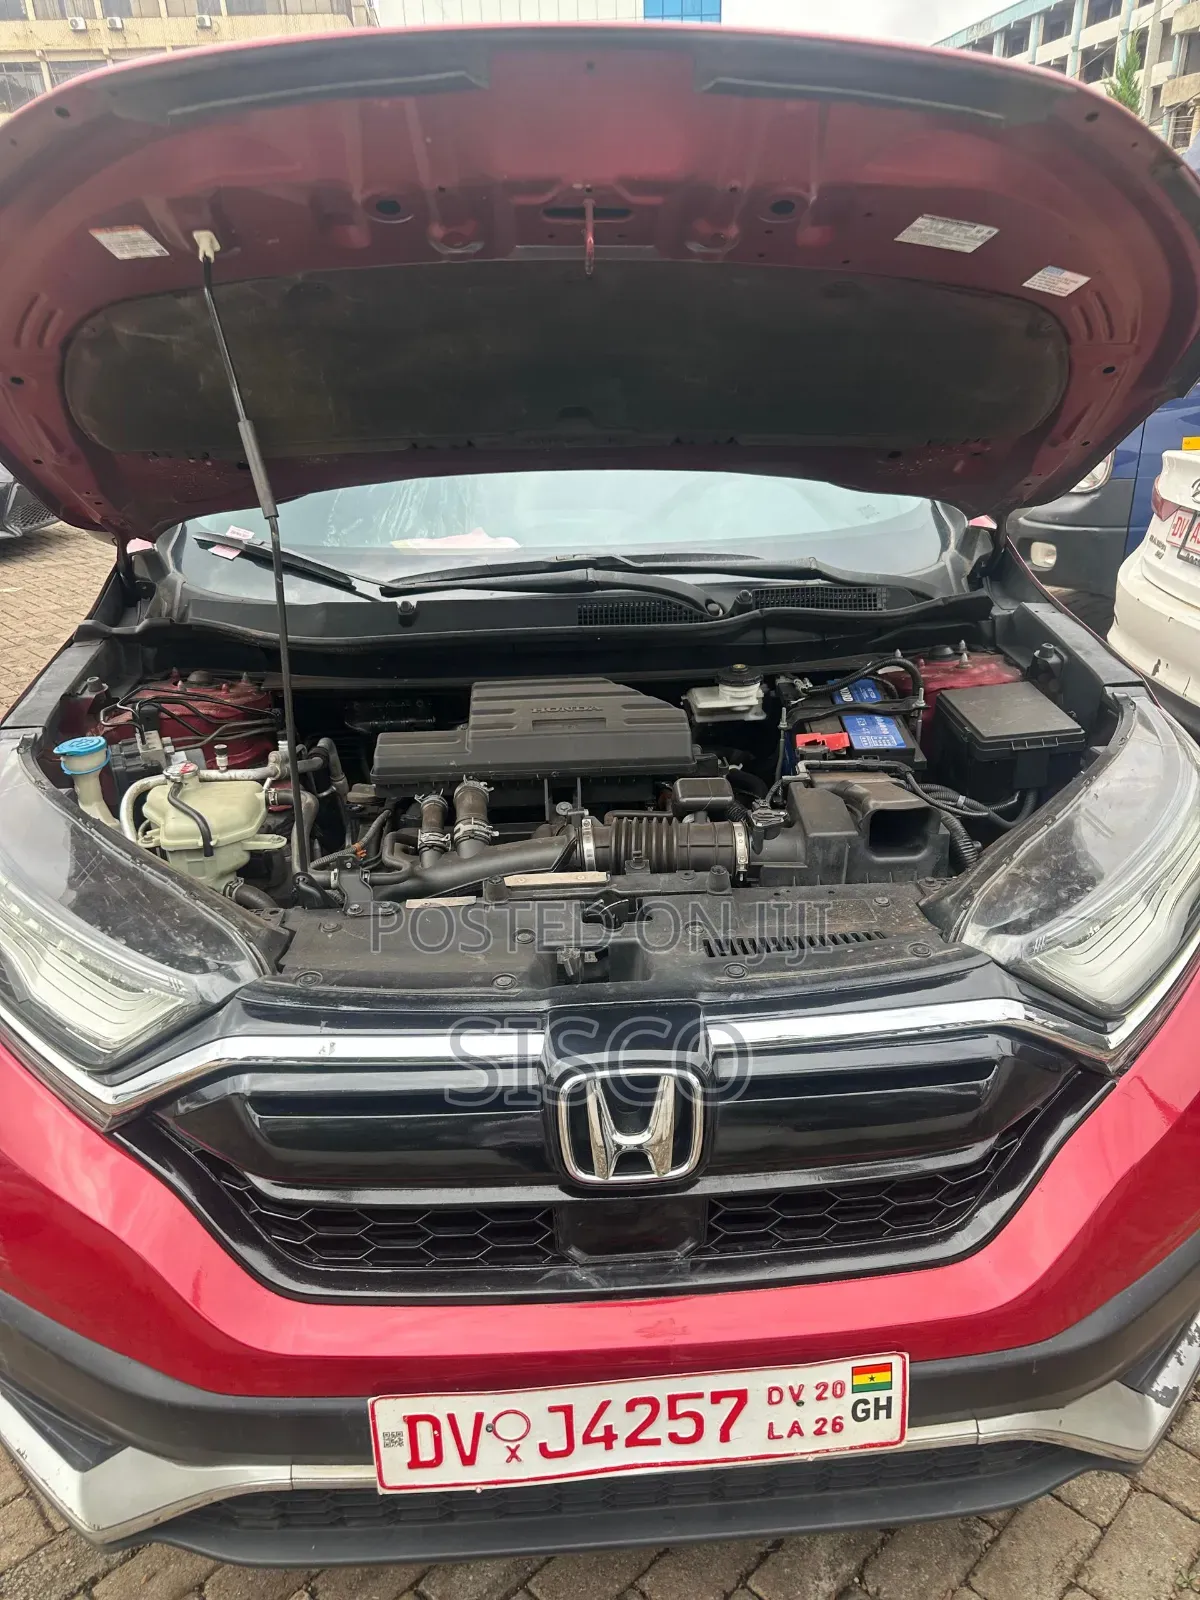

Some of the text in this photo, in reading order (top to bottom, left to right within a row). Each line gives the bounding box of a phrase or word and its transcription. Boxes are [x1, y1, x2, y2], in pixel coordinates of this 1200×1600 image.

[531, 705, 603, 713] HONDA
[767, 1379, 846, 1406] DV 20
[851, 1395, 893, 1423] GH
[402, 1411, 485, 1470] DV
[538, 1388, 750, 1460] J4257
[767, 1415, 845, 1441] LA 26
